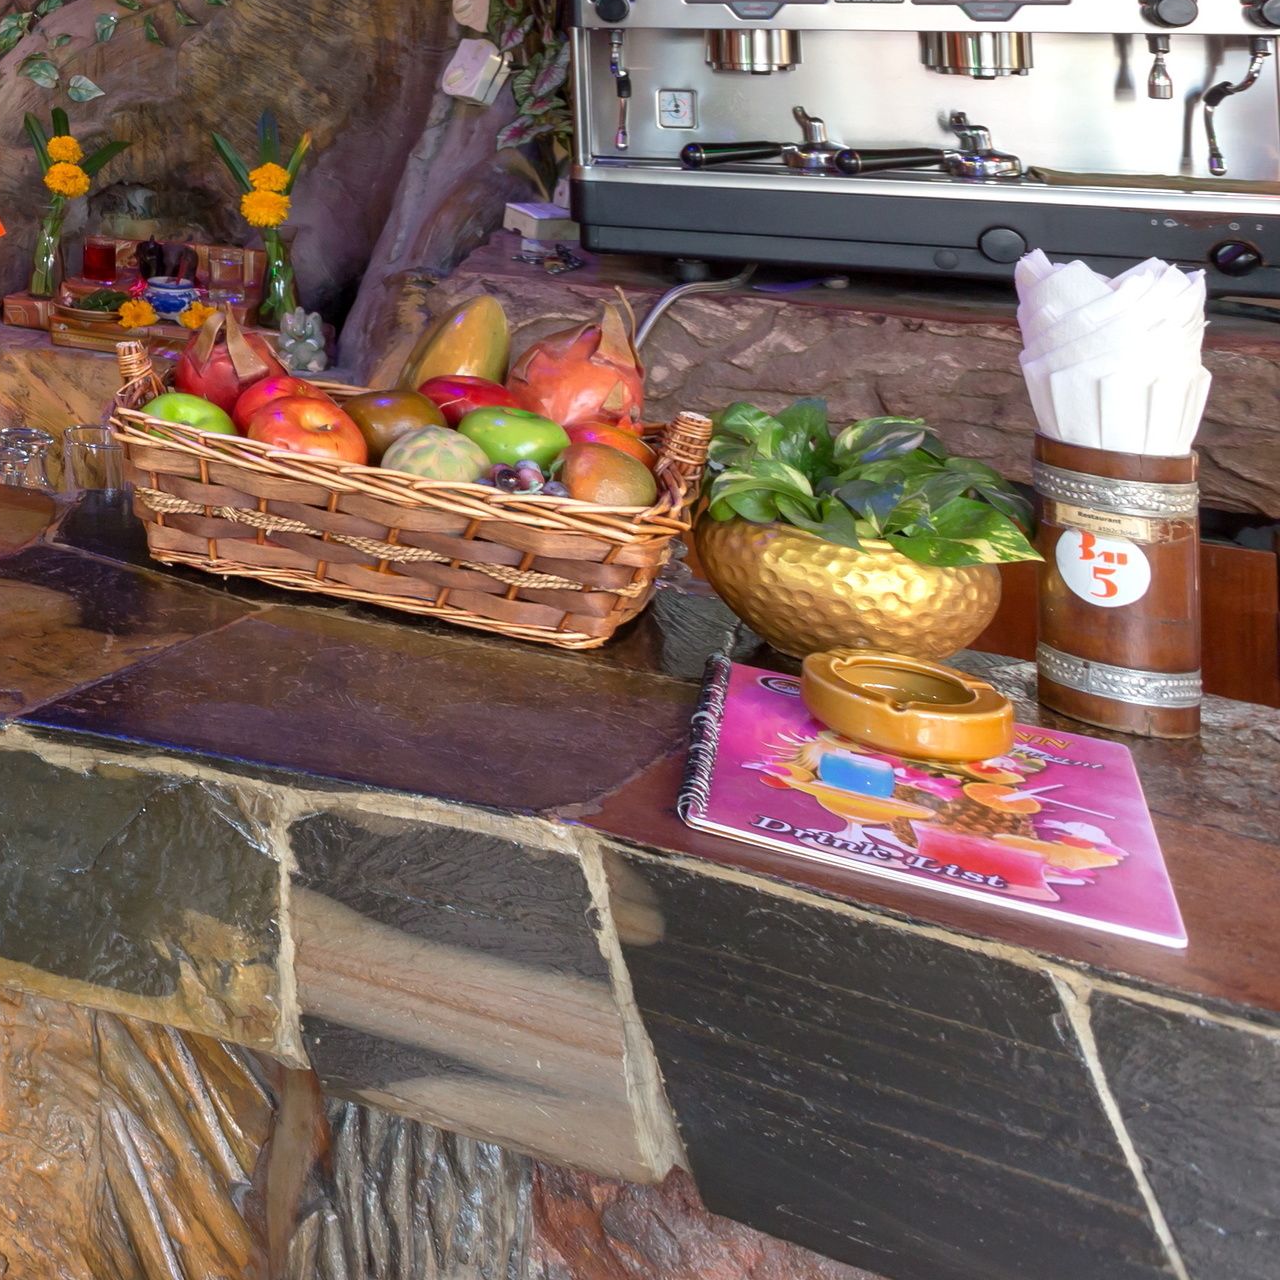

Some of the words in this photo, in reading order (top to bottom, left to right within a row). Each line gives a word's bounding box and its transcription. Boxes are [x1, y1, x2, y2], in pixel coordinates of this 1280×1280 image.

[1077, 511, 1121, 524] Restaurant
[1090, 566, 1119, 598] 5
[751, 814, 892, 861] Drink
[905, 854, 1008, 888] List
